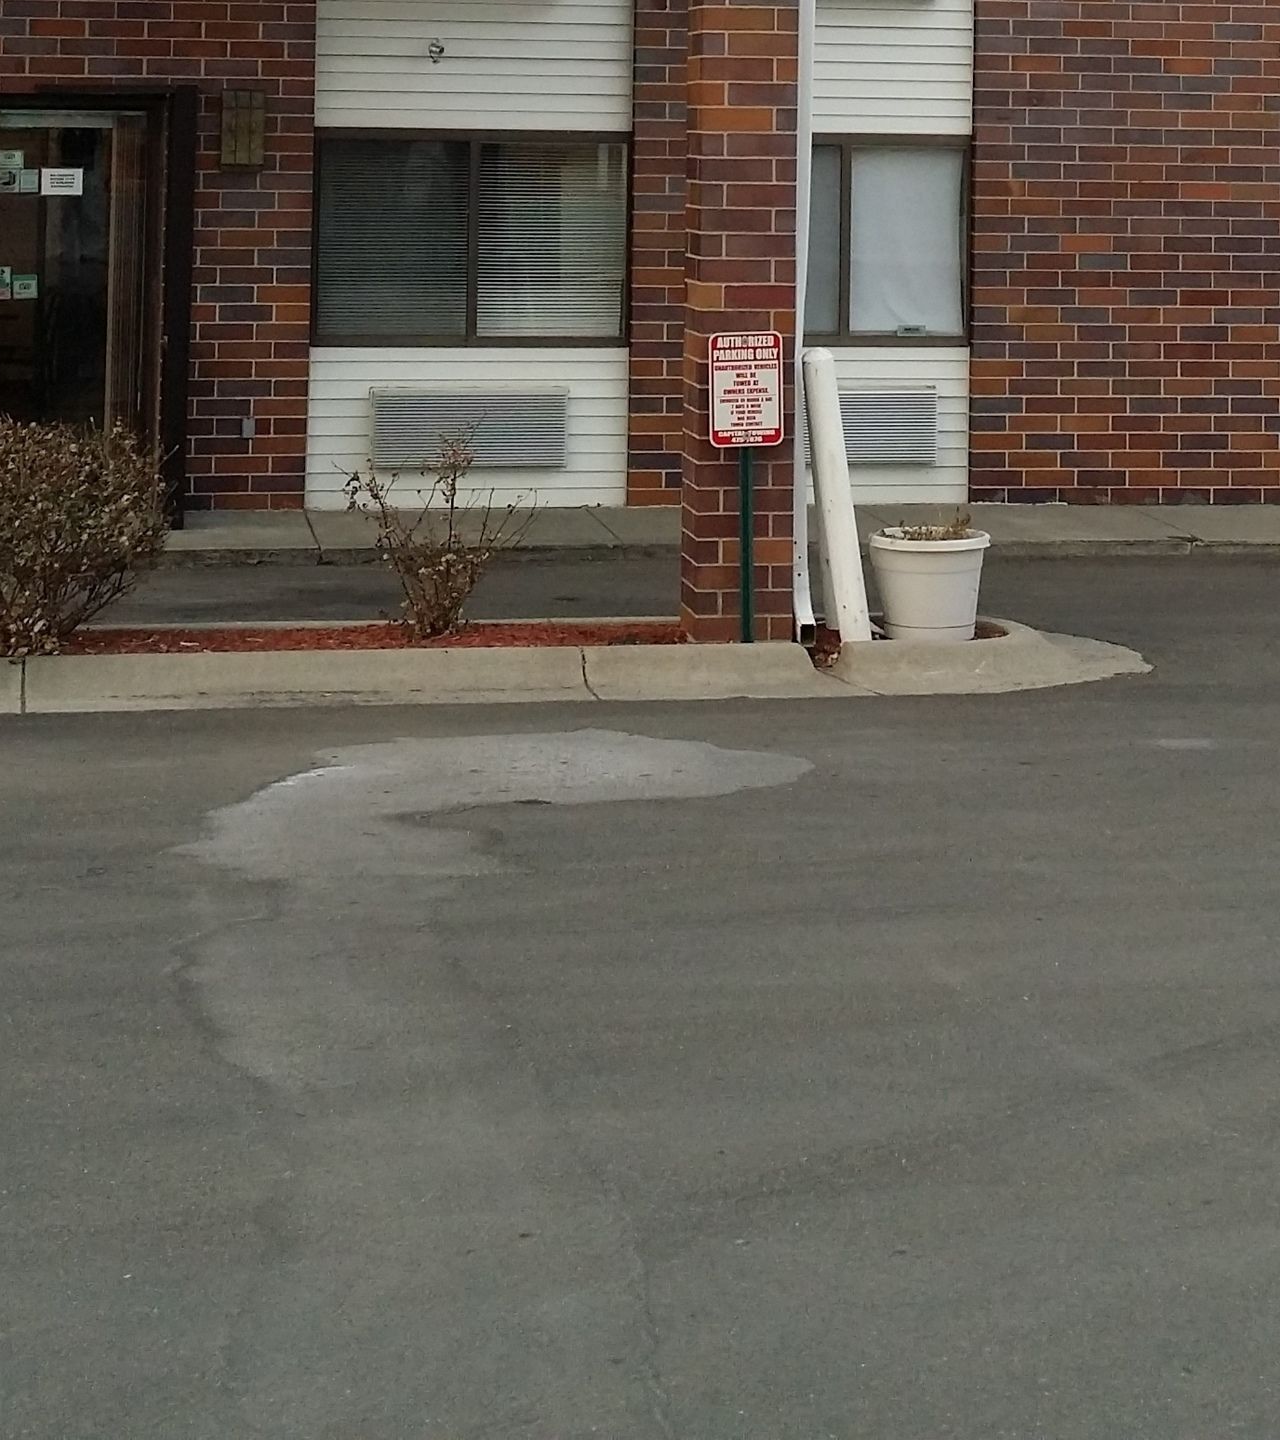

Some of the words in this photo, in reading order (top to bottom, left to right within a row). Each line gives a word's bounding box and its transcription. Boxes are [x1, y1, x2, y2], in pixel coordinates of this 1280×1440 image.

[717, 335, 774, 348] AUTHORIZED
[713, 349, 754, 361] PARKING
[755, 347, 779, 360] ONLY
